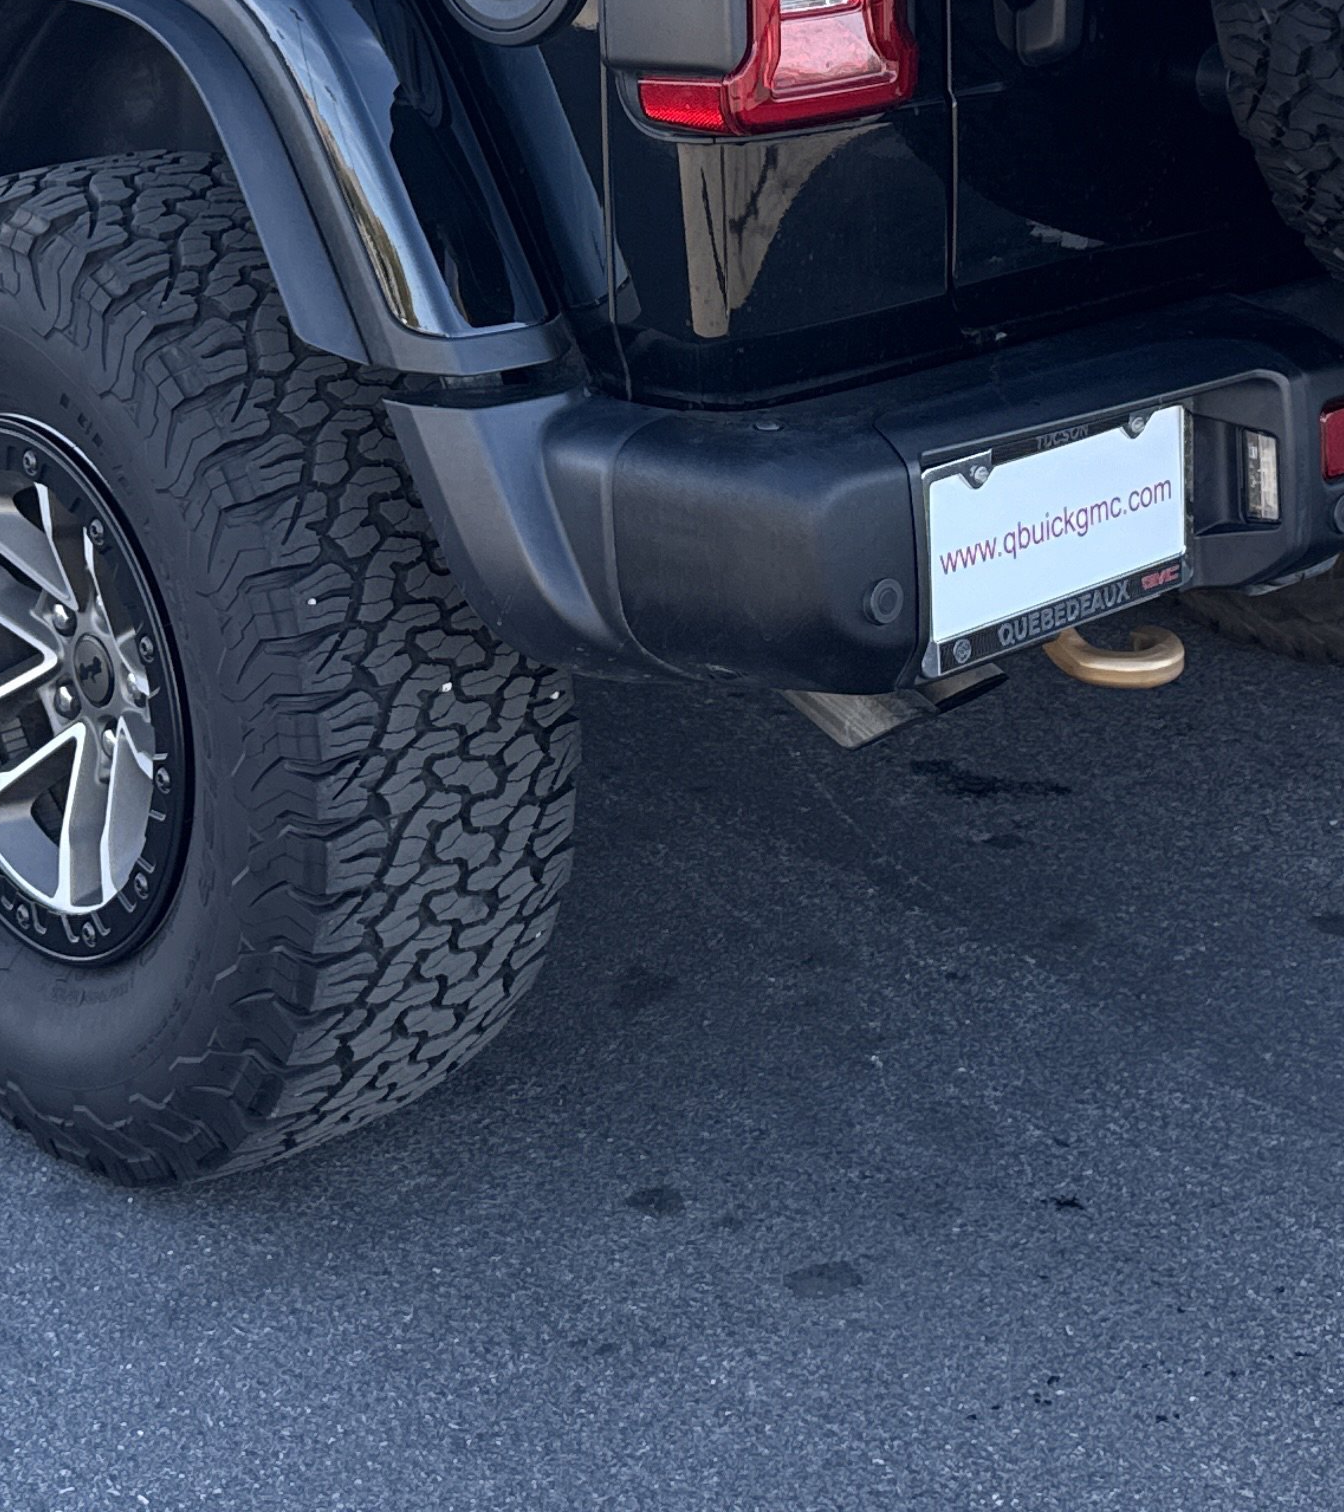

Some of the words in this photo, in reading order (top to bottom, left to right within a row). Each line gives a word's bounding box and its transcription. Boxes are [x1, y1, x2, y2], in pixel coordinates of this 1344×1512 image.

[1035, 424, 1089, 450] TUCSON
[940, 478, 1172, 575] www.qbuickgmc.com
[997, 579, 1131, 647] QUEBEDEAUX
[1140, 564, 1180, 590] GMC
